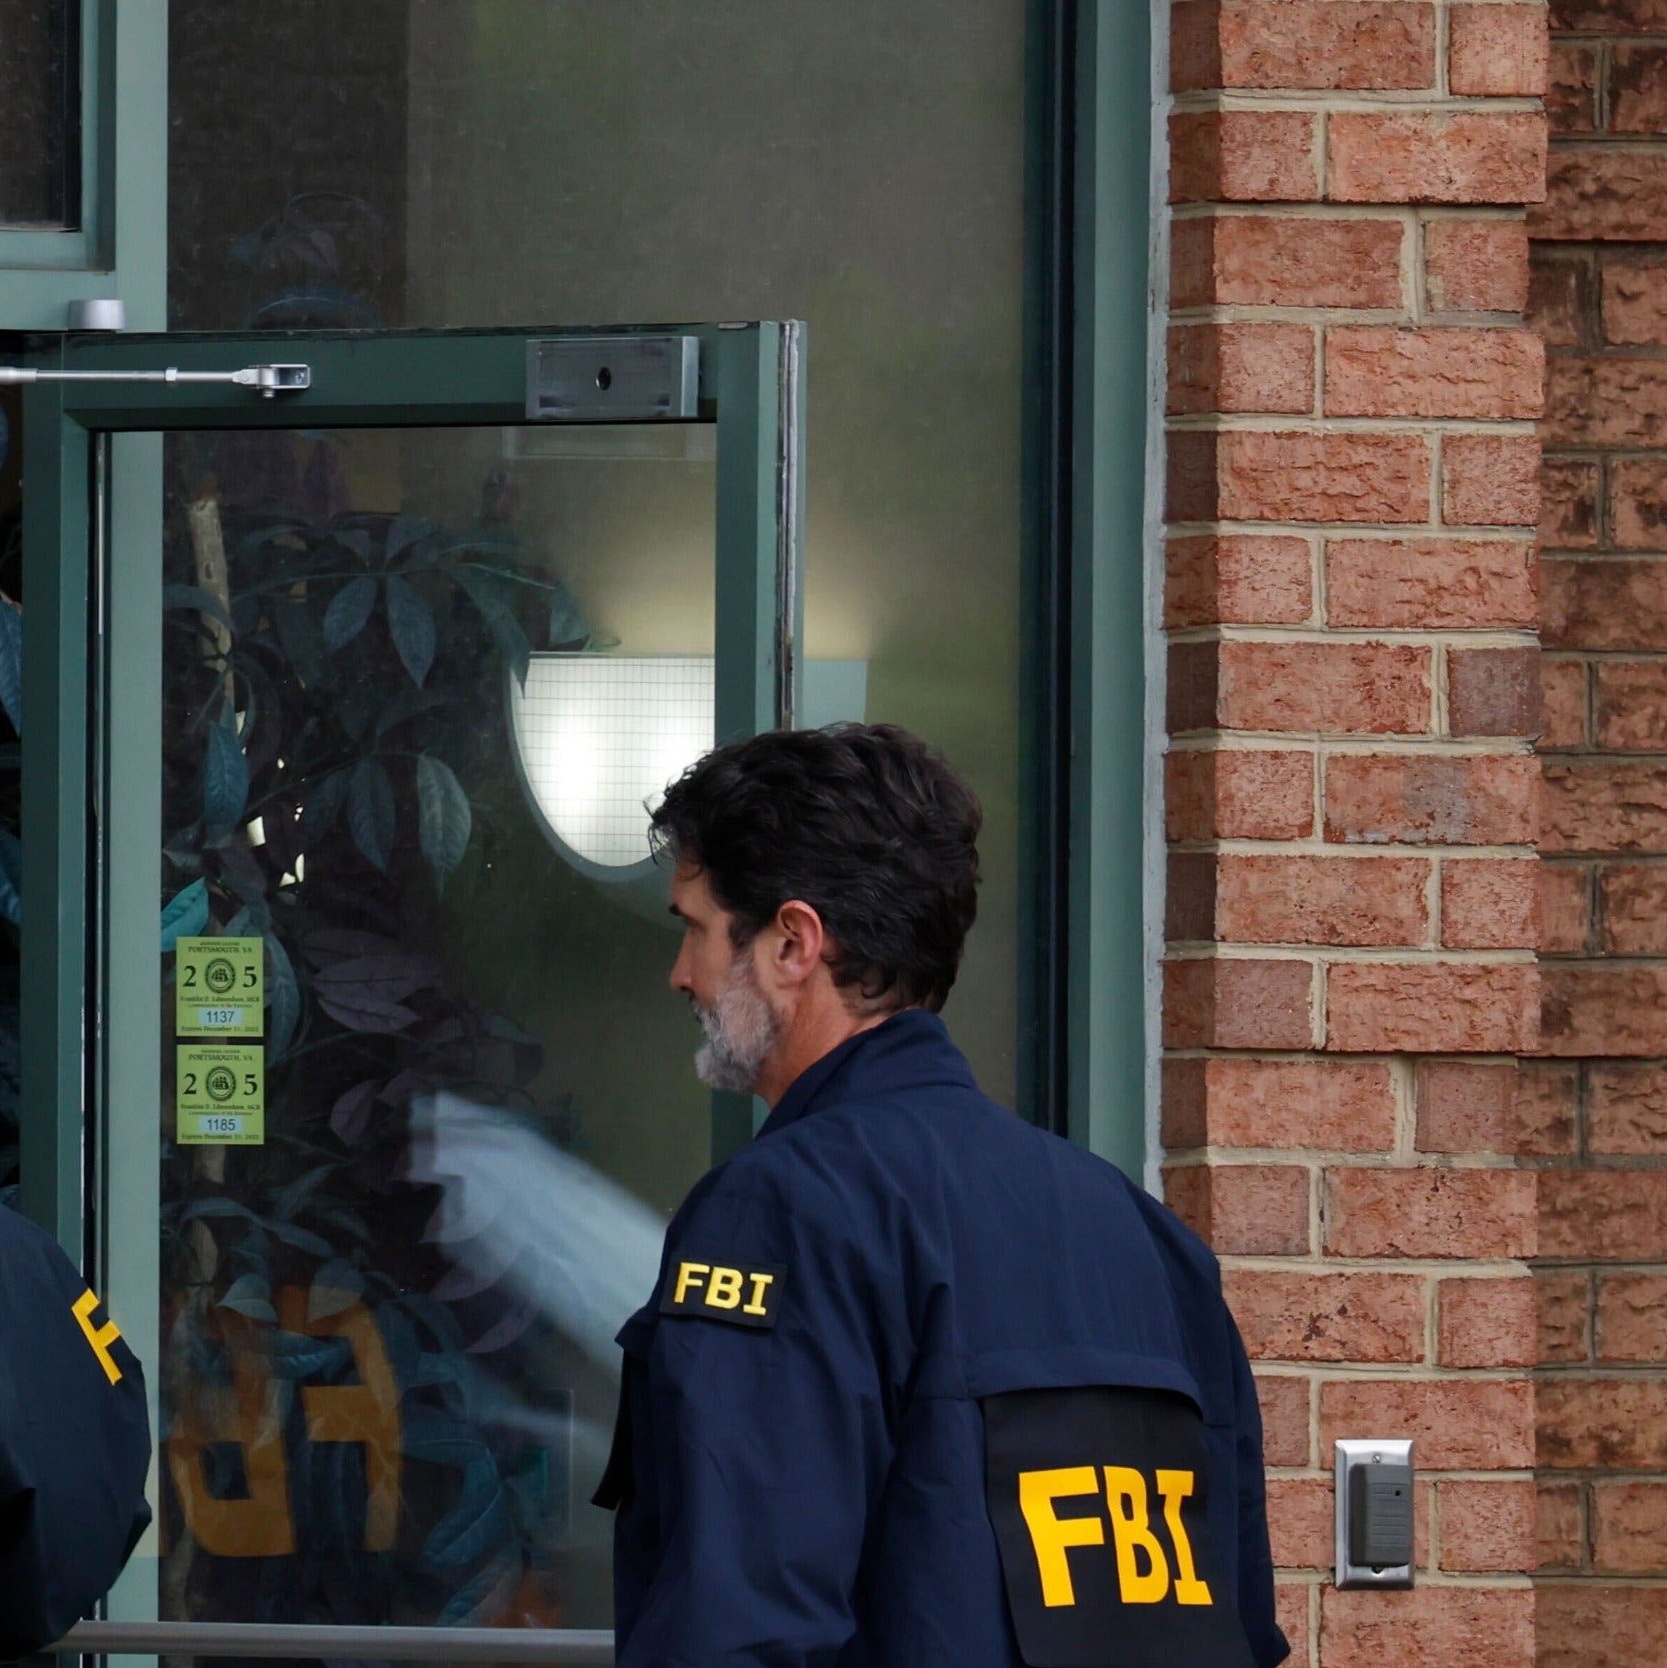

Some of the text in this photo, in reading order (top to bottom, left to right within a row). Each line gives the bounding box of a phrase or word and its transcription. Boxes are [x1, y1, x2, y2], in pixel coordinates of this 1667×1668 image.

[183, 965, 257, 988] 2 5
[207, 1010, 235, 1023] 1137
[183, 1073, 258, 1096] 2 5
[207, 1118, 236, 1131] 1185
[673, 1262, 774, 1316] FBI
[1017, 1464, 1214, 1608] FBI
